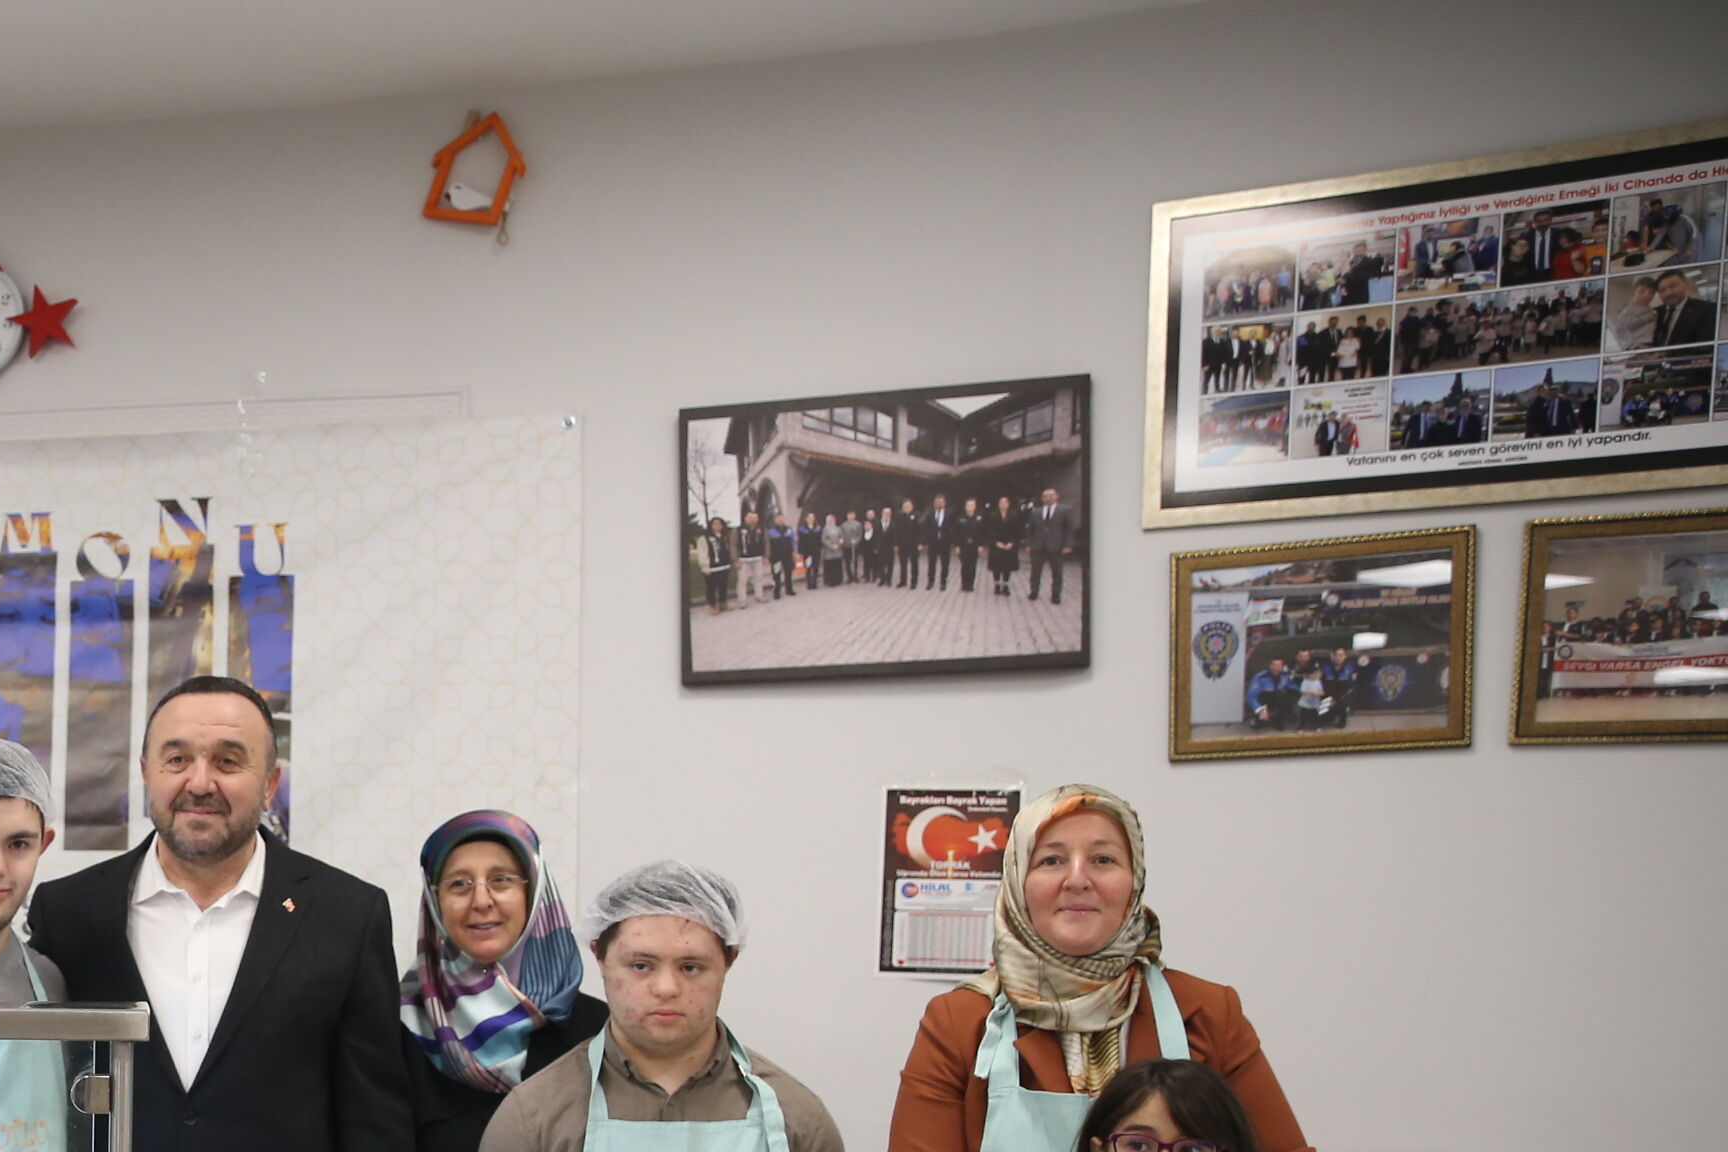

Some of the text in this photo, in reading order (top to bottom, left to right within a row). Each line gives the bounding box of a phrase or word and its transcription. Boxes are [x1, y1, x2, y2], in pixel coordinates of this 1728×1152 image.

[1474, 204, 1489, 212] ve
[1493, 192, 1555, 209] Verdiğiniz
[1559, 185, 1600, 200] Emeği
[1605, 180, 1619, 193] İki
[1623, 173, 1683, 191] Cihanda
[1688, 170, 1708, 181] da
[1, 294, 10, 306] 2
[1400, 454, 1416, 462] en
[1420, 450, 1445, 462] çok
[1448, 448, 1485, 458] seven
[1489, 440, 1542, 456] görevini
[1546, 441, 1563, 449] en
[1568, 437, 1582, 449] iyi
[1586, 431, 1652, 447] yapandır.
